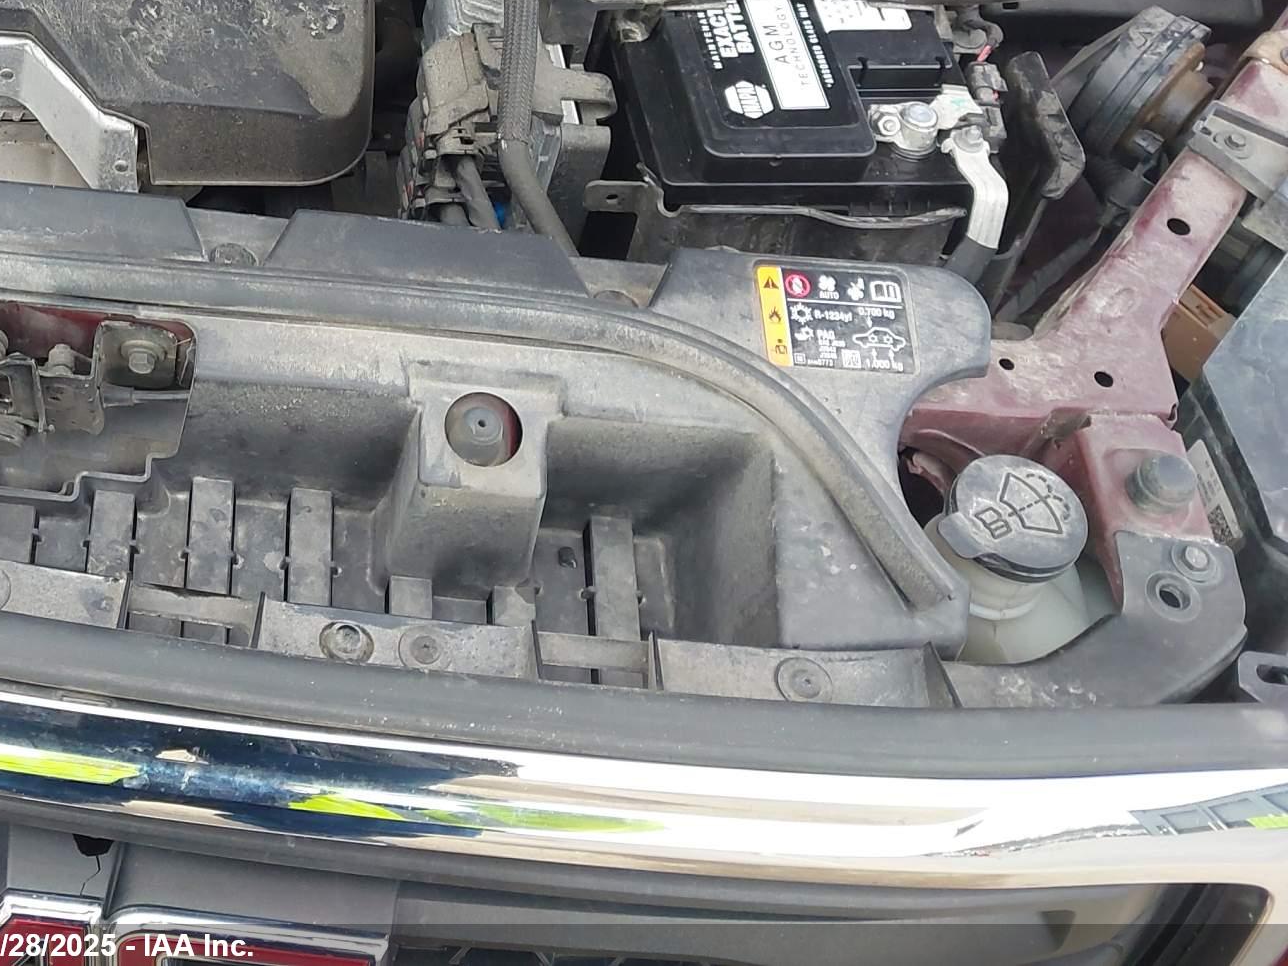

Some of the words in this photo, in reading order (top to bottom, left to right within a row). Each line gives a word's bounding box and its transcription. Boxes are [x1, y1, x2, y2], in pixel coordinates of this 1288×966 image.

[762, 25, 791, 65] AGM
[776, 6, 811, 87] TECHNOLOGY
[819, 291, 839, 299] AUTO
[883, 308, 895, 319] kg
